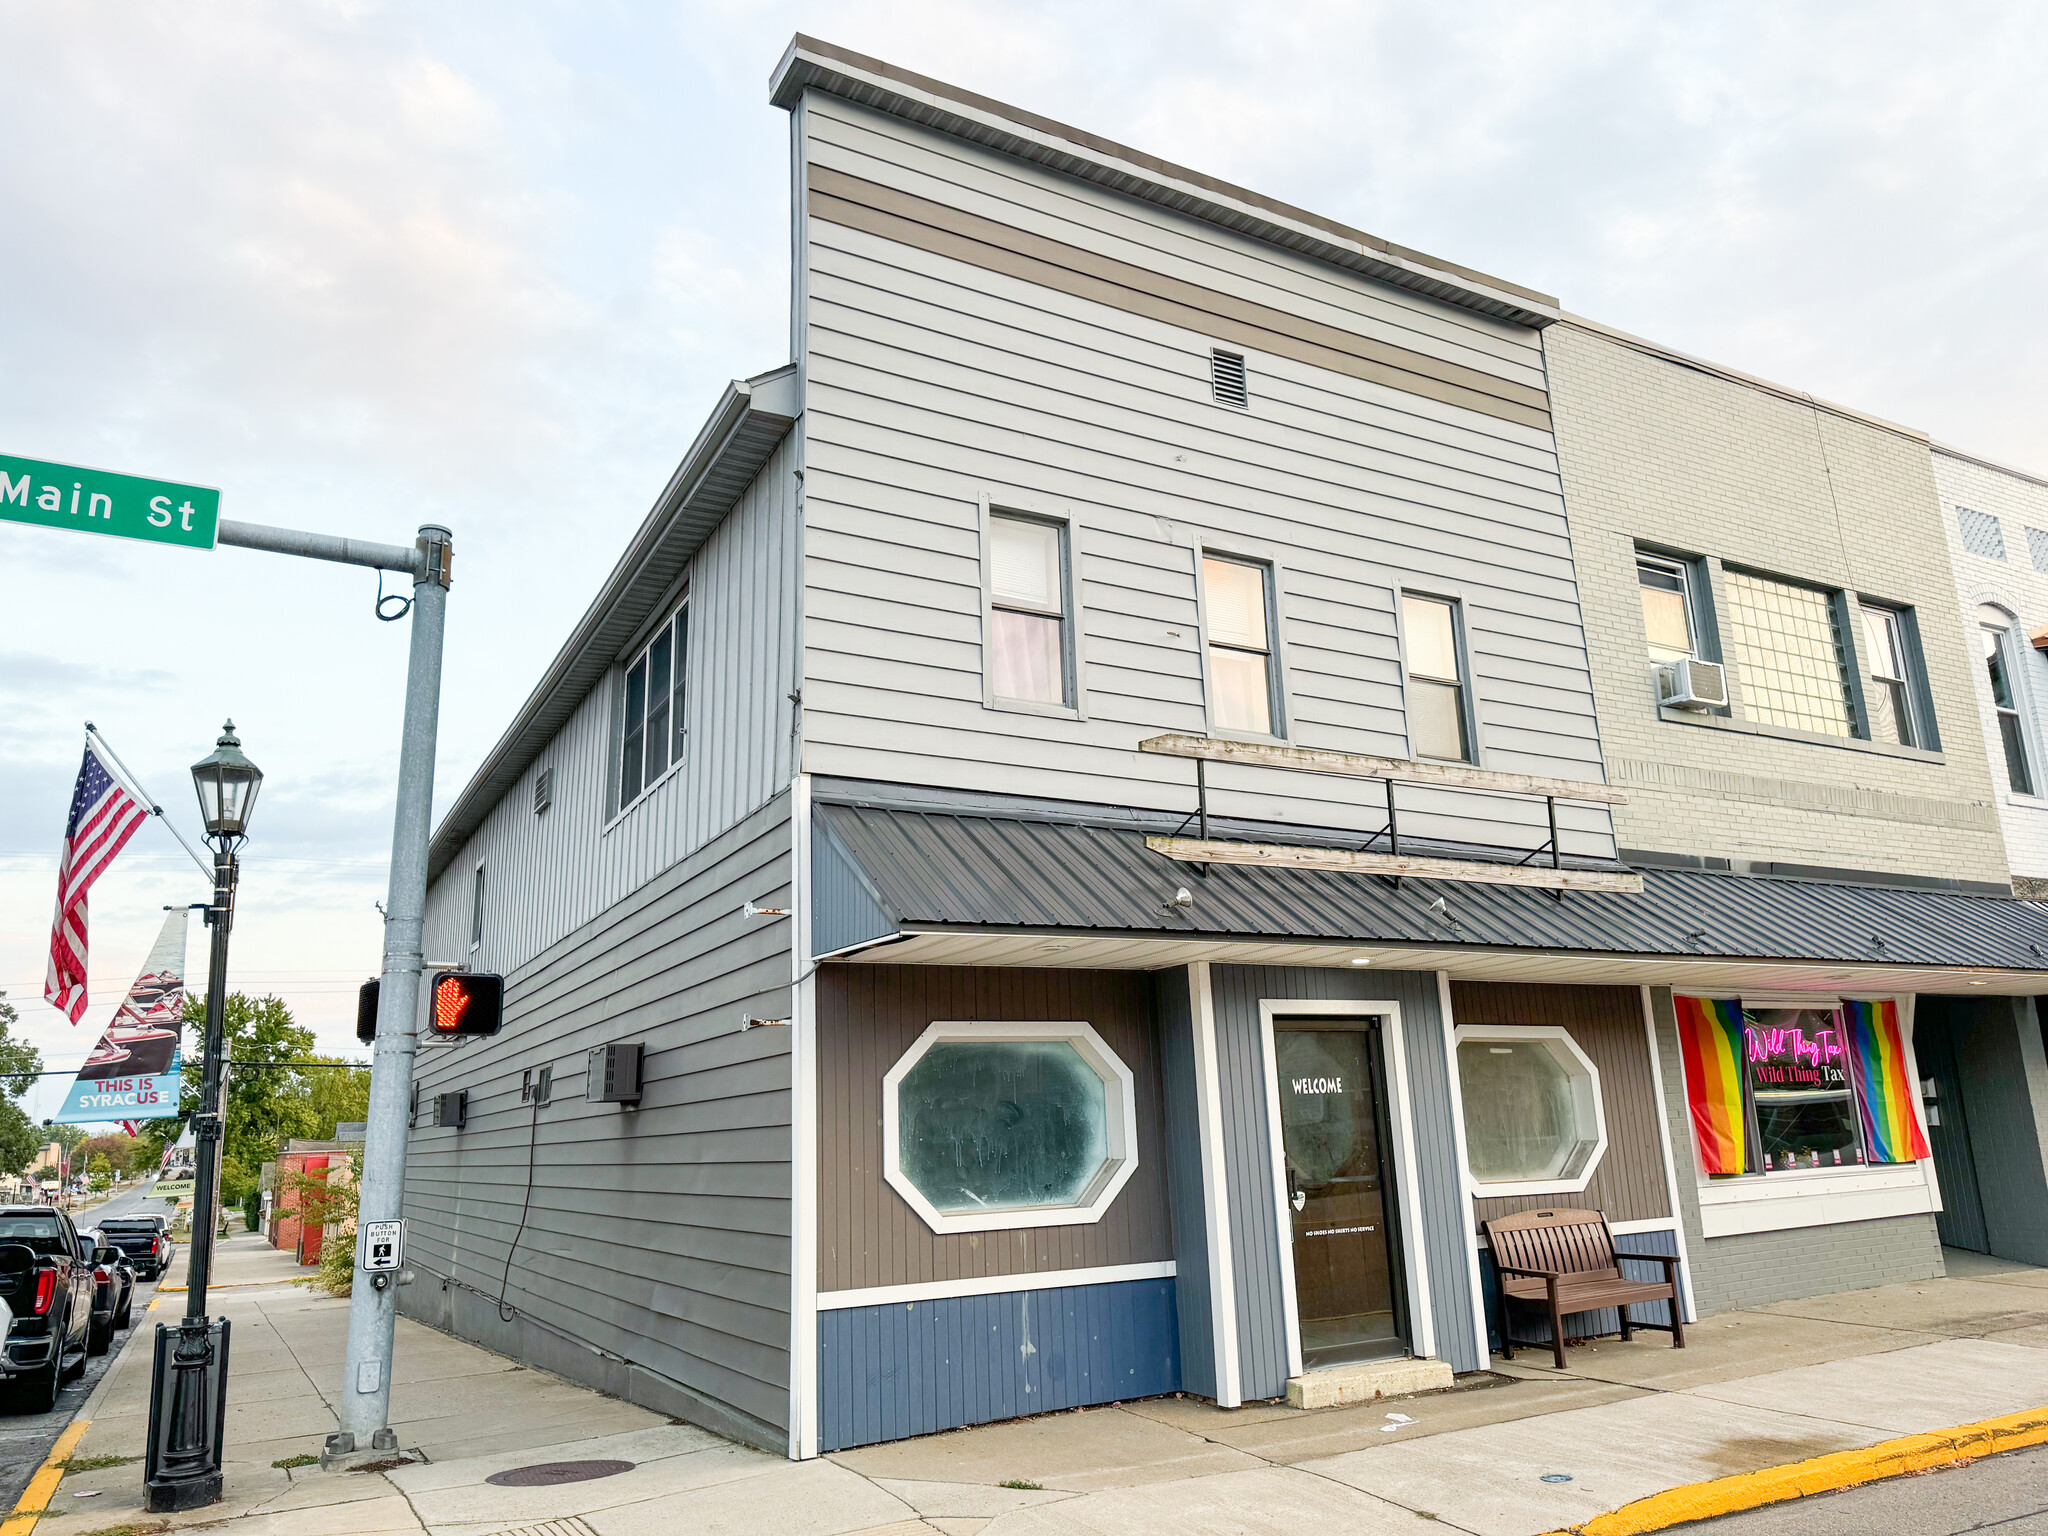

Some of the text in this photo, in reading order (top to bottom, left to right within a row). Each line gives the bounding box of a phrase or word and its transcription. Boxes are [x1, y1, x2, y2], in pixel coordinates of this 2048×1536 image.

[0, 470, 196, 532] Main St
[1745, 1027, 1842, 1067] Wild Thing Tax
[95, 1078, 153, 1092] THIS IS
[1756, 1065, 1846, 1087] Wild Thing Tax
[1291, 1077, 1343, 1095] WELCOME
[80, 1091, 169, 1108] SYRACUSE
[156, 1183, 191, 1191] WELCOME
